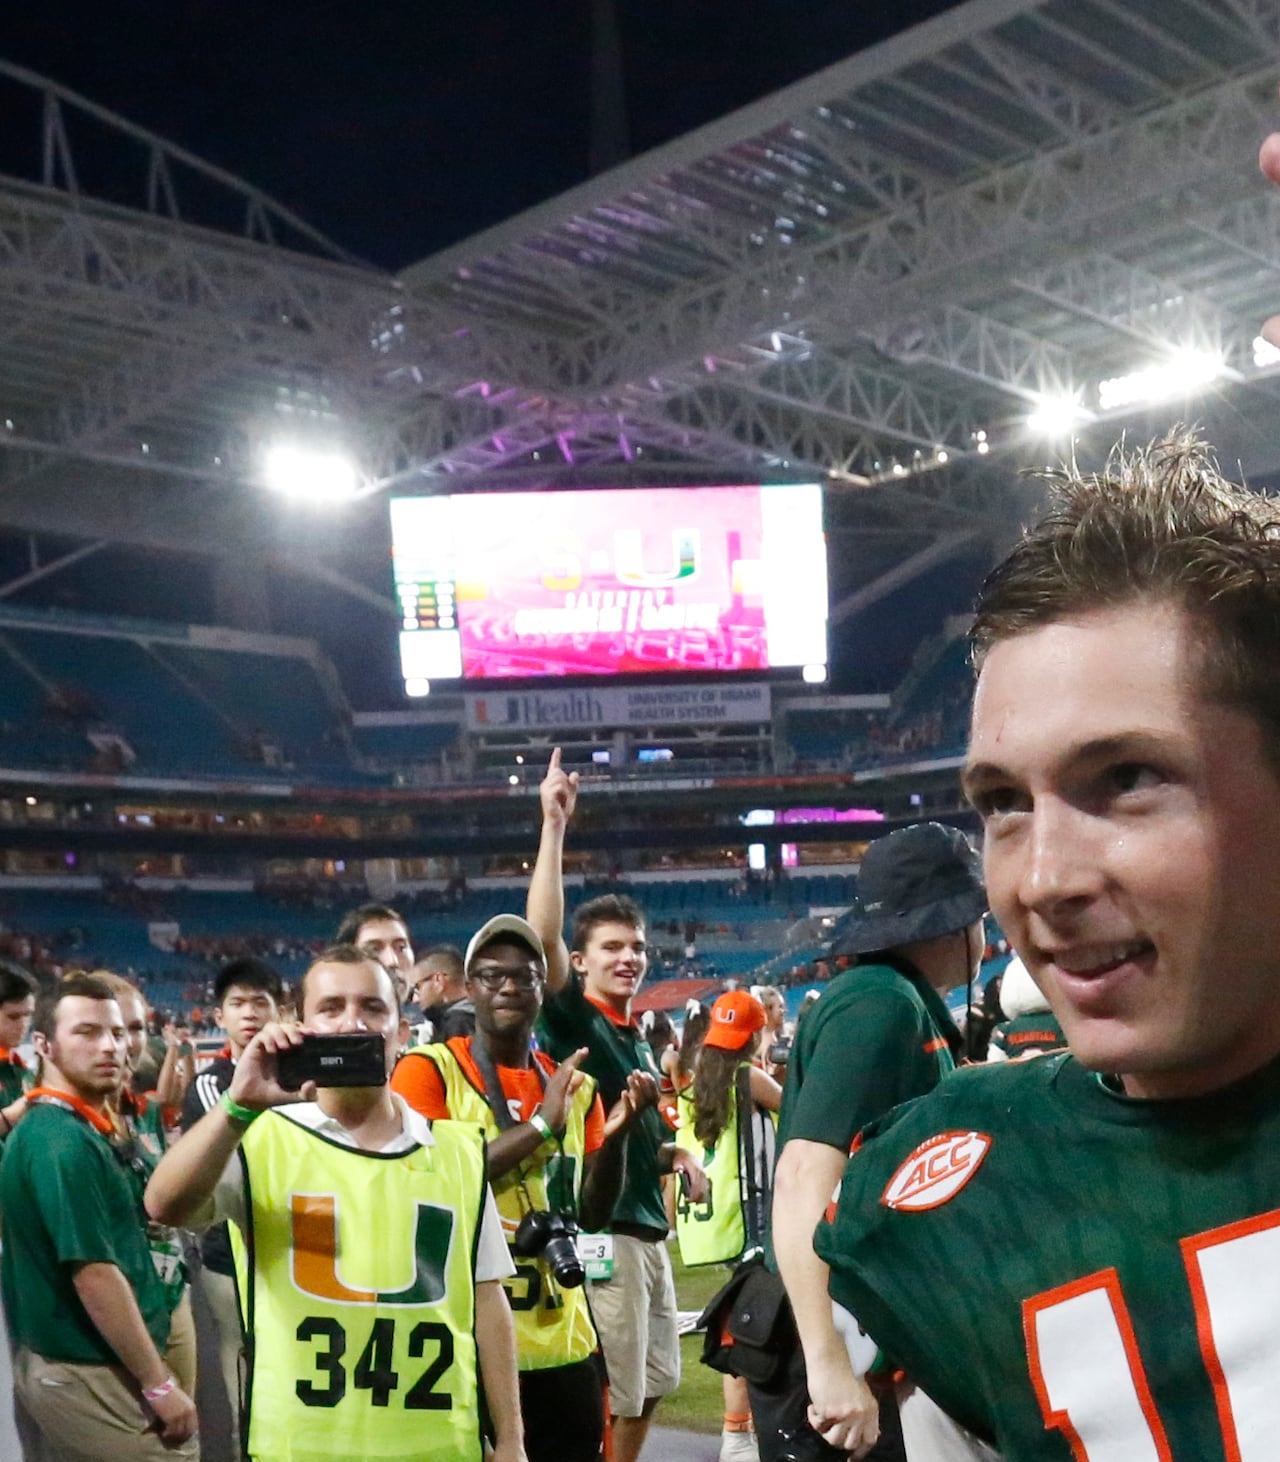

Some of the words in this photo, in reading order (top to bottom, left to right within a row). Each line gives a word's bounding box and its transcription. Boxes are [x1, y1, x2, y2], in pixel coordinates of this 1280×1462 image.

[627, 691, 700, 705] UNIVERSITY
[679, 704, 726, 718] SYSTEM
[897, 1136, 972, 1196] ACC
[289, 1193, 455, 1307] U
[596, 1245, 606, 1259] 3
[294, 1316, 454, 1410] 342
